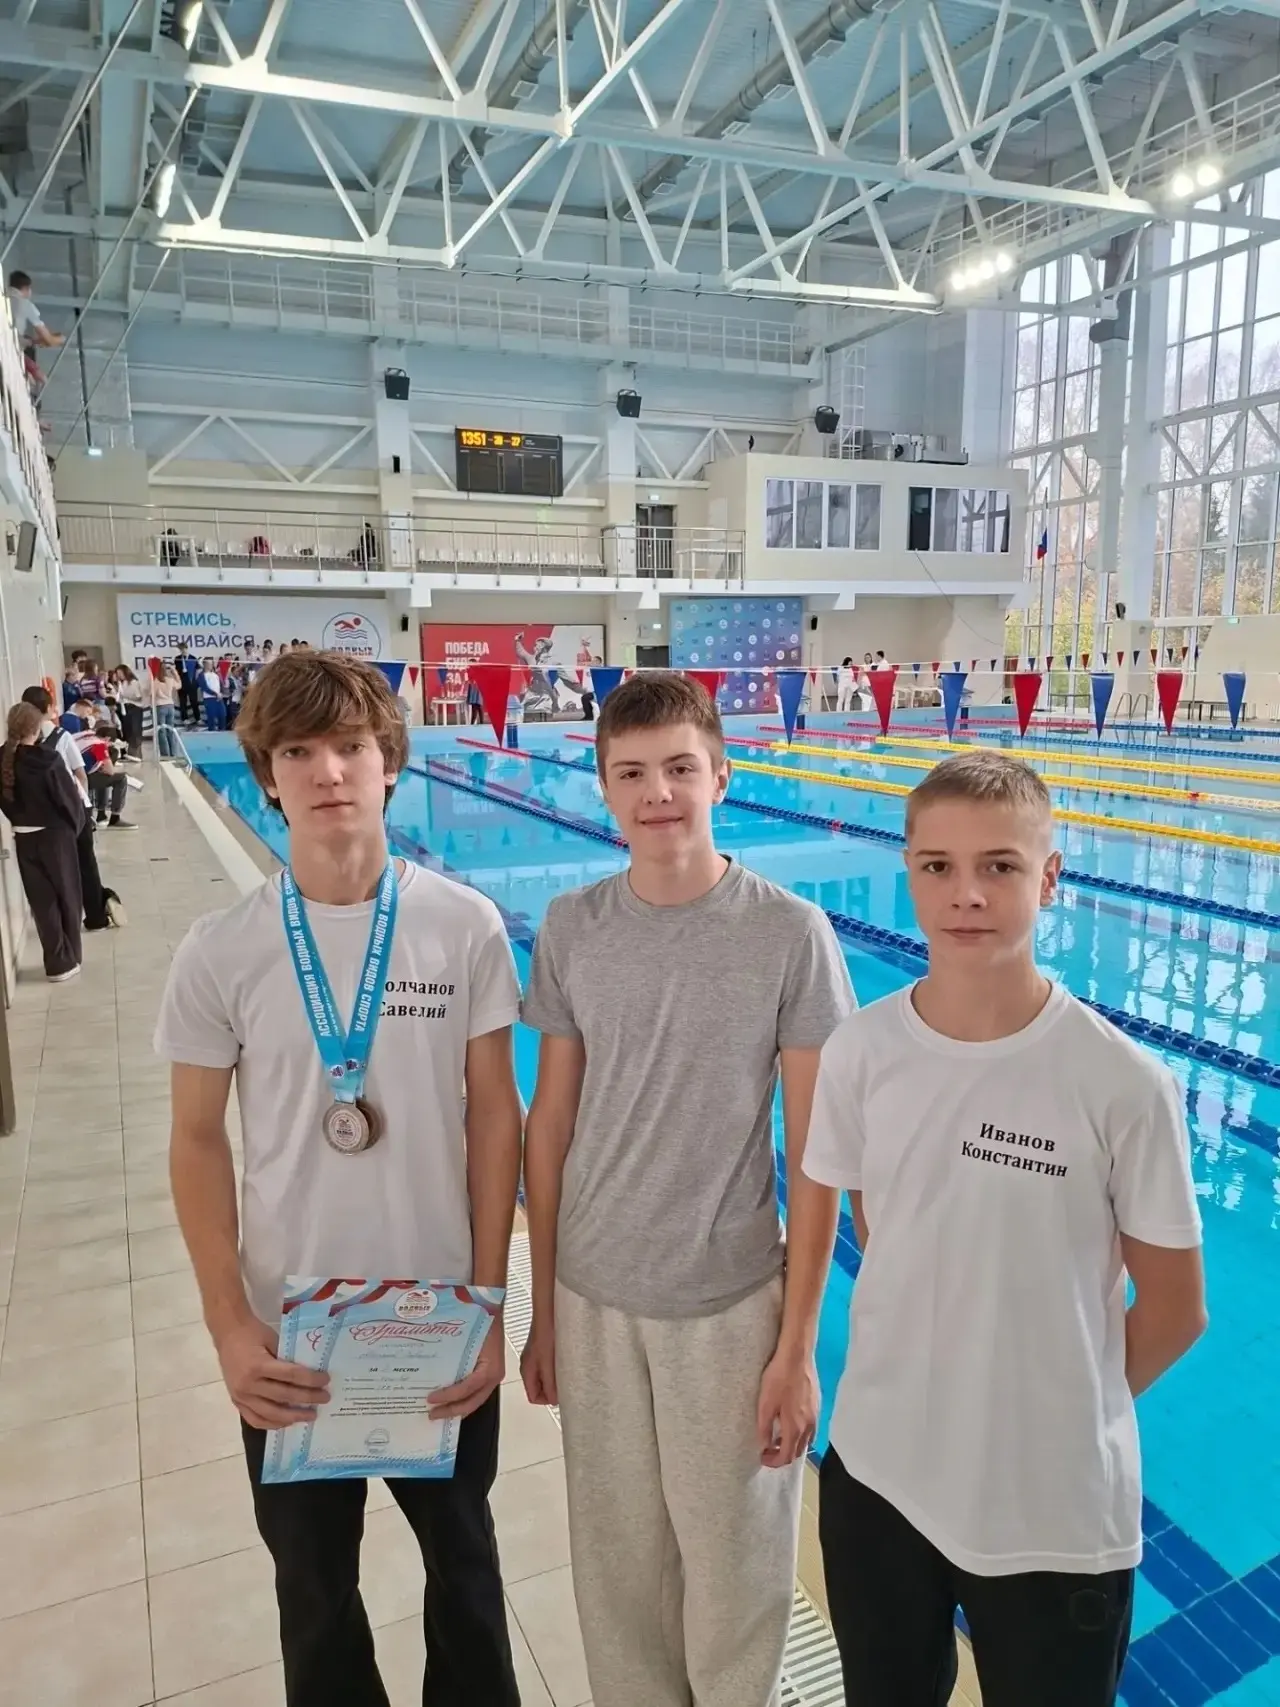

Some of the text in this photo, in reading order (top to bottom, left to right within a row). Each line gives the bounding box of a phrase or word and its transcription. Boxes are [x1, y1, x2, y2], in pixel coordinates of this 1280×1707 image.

[130, 611, 236, 628] СТРЕМИСЬ,
[445, 641, 490, 656] ПОБЕДА
[286, 896, 301, 927] ВИДОВ
[292, 929, 313, 972] ВОДНЫХ
[372, 913, 389, 956] ВОДНЫХ
[363, 957, 380, 992] ВИДОВ
[384, 980, 455, 996] олчанов
[304, 974, 332, 1037] АССОЦИАЦИЯ
[354, 993, 373, 1032] СПОРТА
[979, 1122, 1056, 1153] Иванов
[960, 1140, 1068, 1178] Константин
